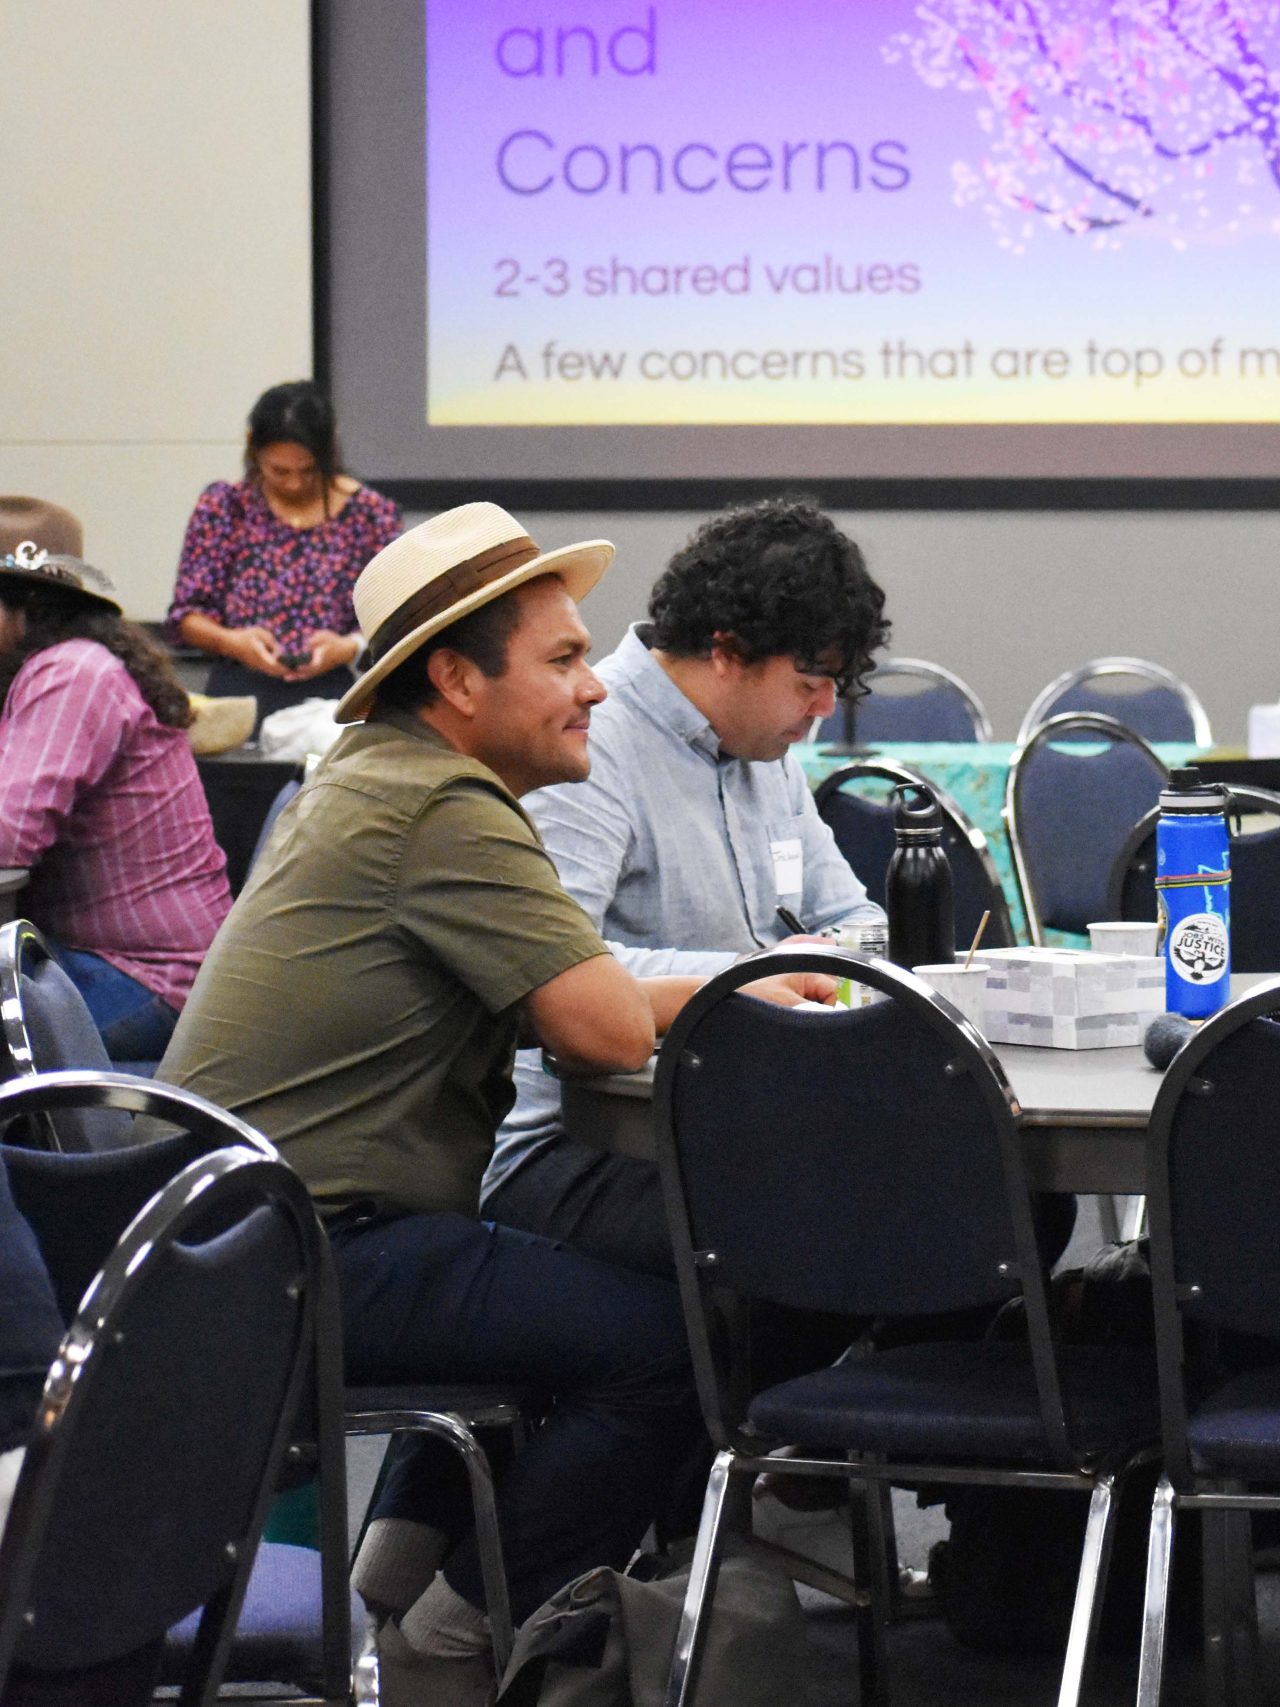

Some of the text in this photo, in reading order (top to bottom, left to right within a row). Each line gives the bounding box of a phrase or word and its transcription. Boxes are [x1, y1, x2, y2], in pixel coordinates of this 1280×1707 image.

[497, 5, 656, 77] and
[497, 129, 911, 196] Concerns
[494, 254, 922, 298] 2-3 shared values
[493, 342, 527, 381] A
[541, 340, 627, 381] few
[639, 348, 866, 381] concerns
[879, 338, 975, 379] that
[991, 346, 1070, 380] are
[1085, 338, 1164, 387] top
[1178, 337, 1225, 379] of
[1177, 937, 1225, 957] JUSTICE
